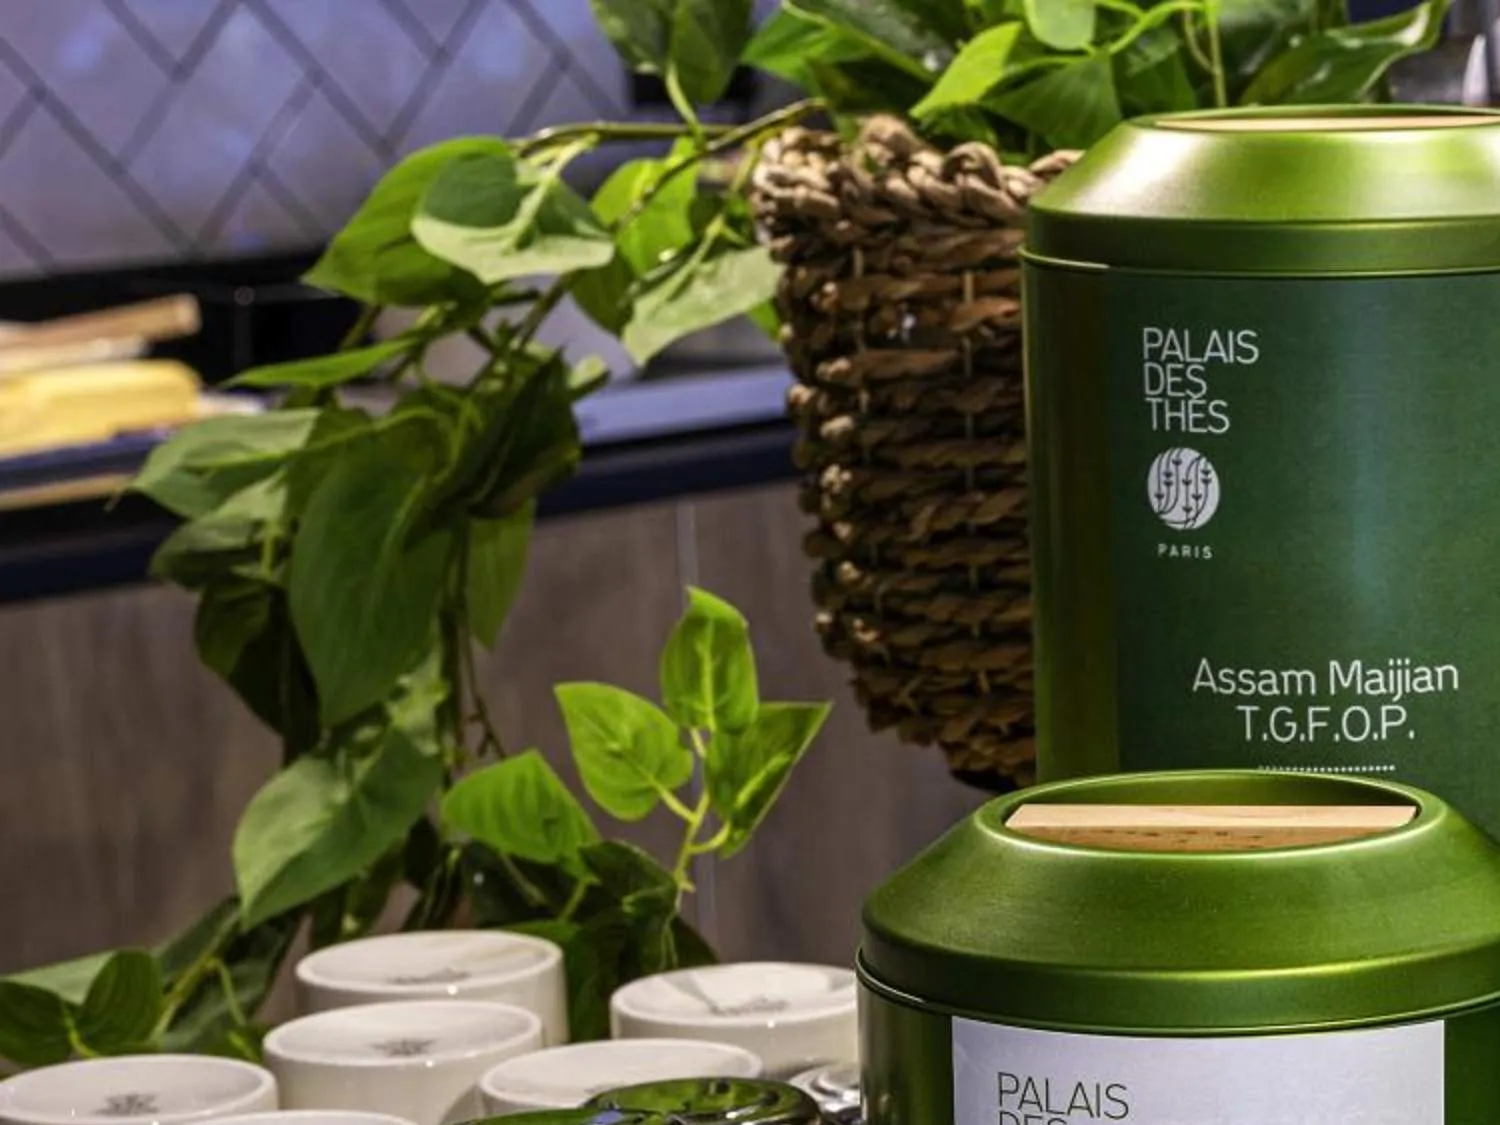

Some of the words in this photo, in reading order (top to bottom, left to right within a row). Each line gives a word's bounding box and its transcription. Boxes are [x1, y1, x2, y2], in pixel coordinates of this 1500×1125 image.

[1142, 326, 1260, 365] PALAIS
[1142, 361, 1207, 398] DES
[1157, 542, 1213, 560] PARIS
[1192, 658, 1317, 698] Assam
[1327, 659, 1460, 702] Maijian
[1236, 705, 1418, 744] T.G.F.O.P.
[997, 1072, 1130, 1120] PALAIS
